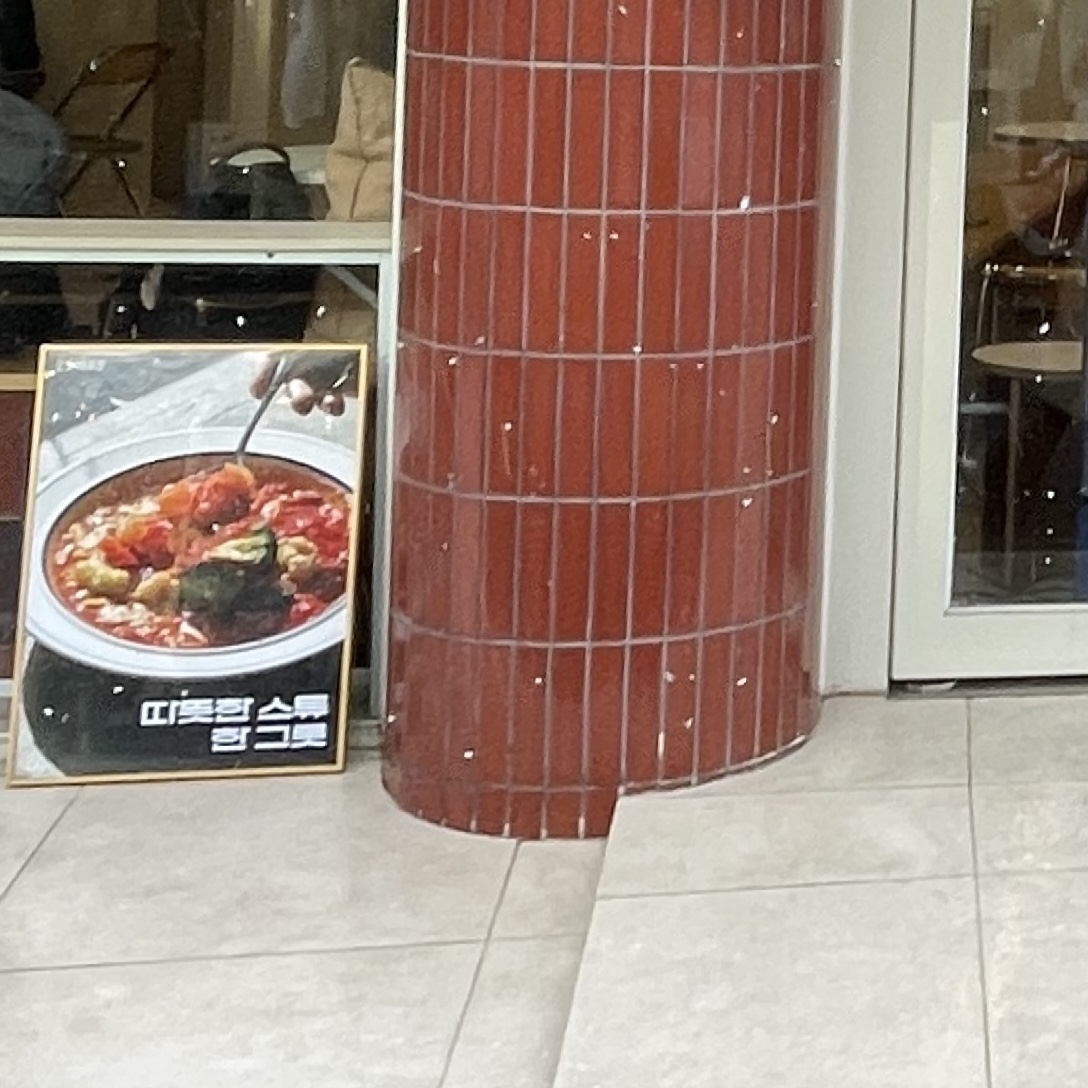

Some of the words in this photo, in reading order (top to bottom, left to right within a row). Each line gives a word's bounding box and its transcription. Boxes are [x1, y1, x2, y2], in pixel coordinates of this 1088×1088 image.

[140, 698, 254, 726] 따뜻한
[257, 693, 329, 720] 스튜
[211, 726, 251, 752] 한
[253, 723, 327, 749] 그릇
